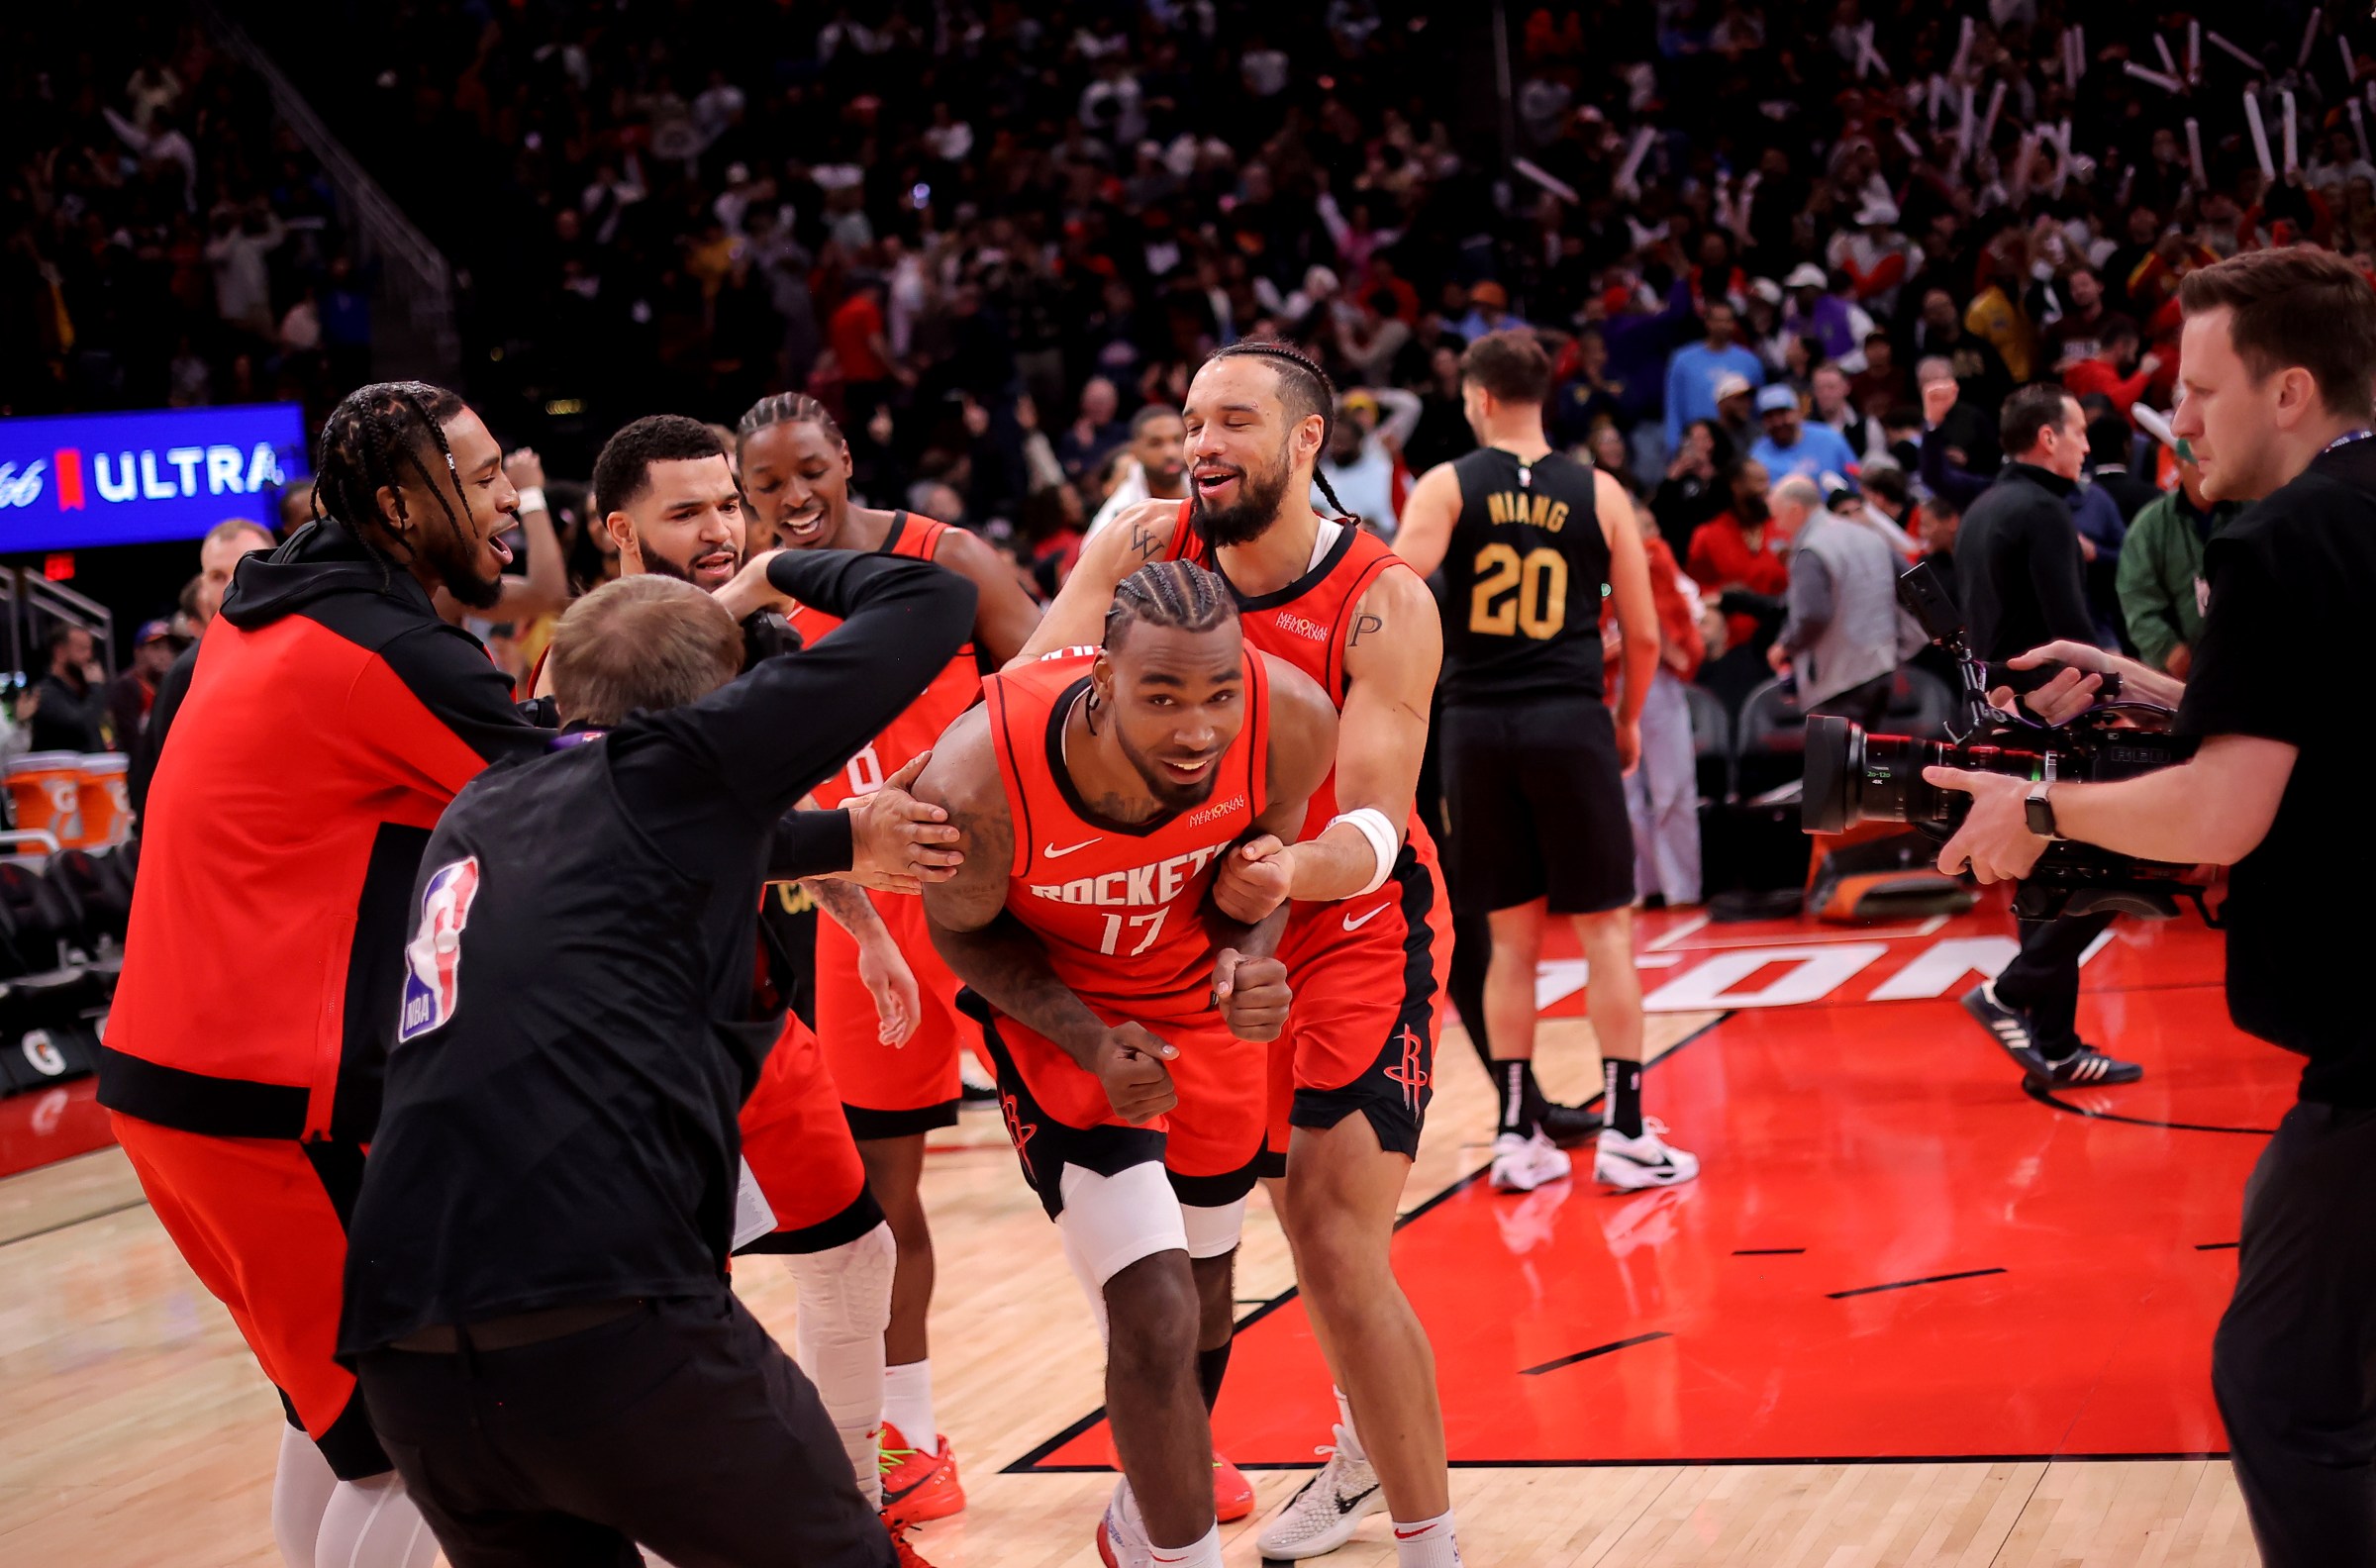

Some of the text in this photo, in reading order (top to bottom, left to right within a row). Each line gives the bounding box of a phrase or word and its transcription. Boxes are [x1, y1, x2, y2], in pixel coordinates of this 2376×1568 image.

[94, 441, 281, 503] ULTRA
[1487, 491, 1570, 534] NIANG
[1468, 542, 1569, 640] 20
[1275, 617, 1328, 641] HERMANN
[1278, 612, 1329, 636] MEMORIAL
[1189, 794, 1244, 821] MEMORIAL
[1189, 798, 1244, 829] HERMANN
[1100, 905, 1170, 957] 17
[405, 993, 430, 1031] NBA
[21, 1028, 67, 1077] G
